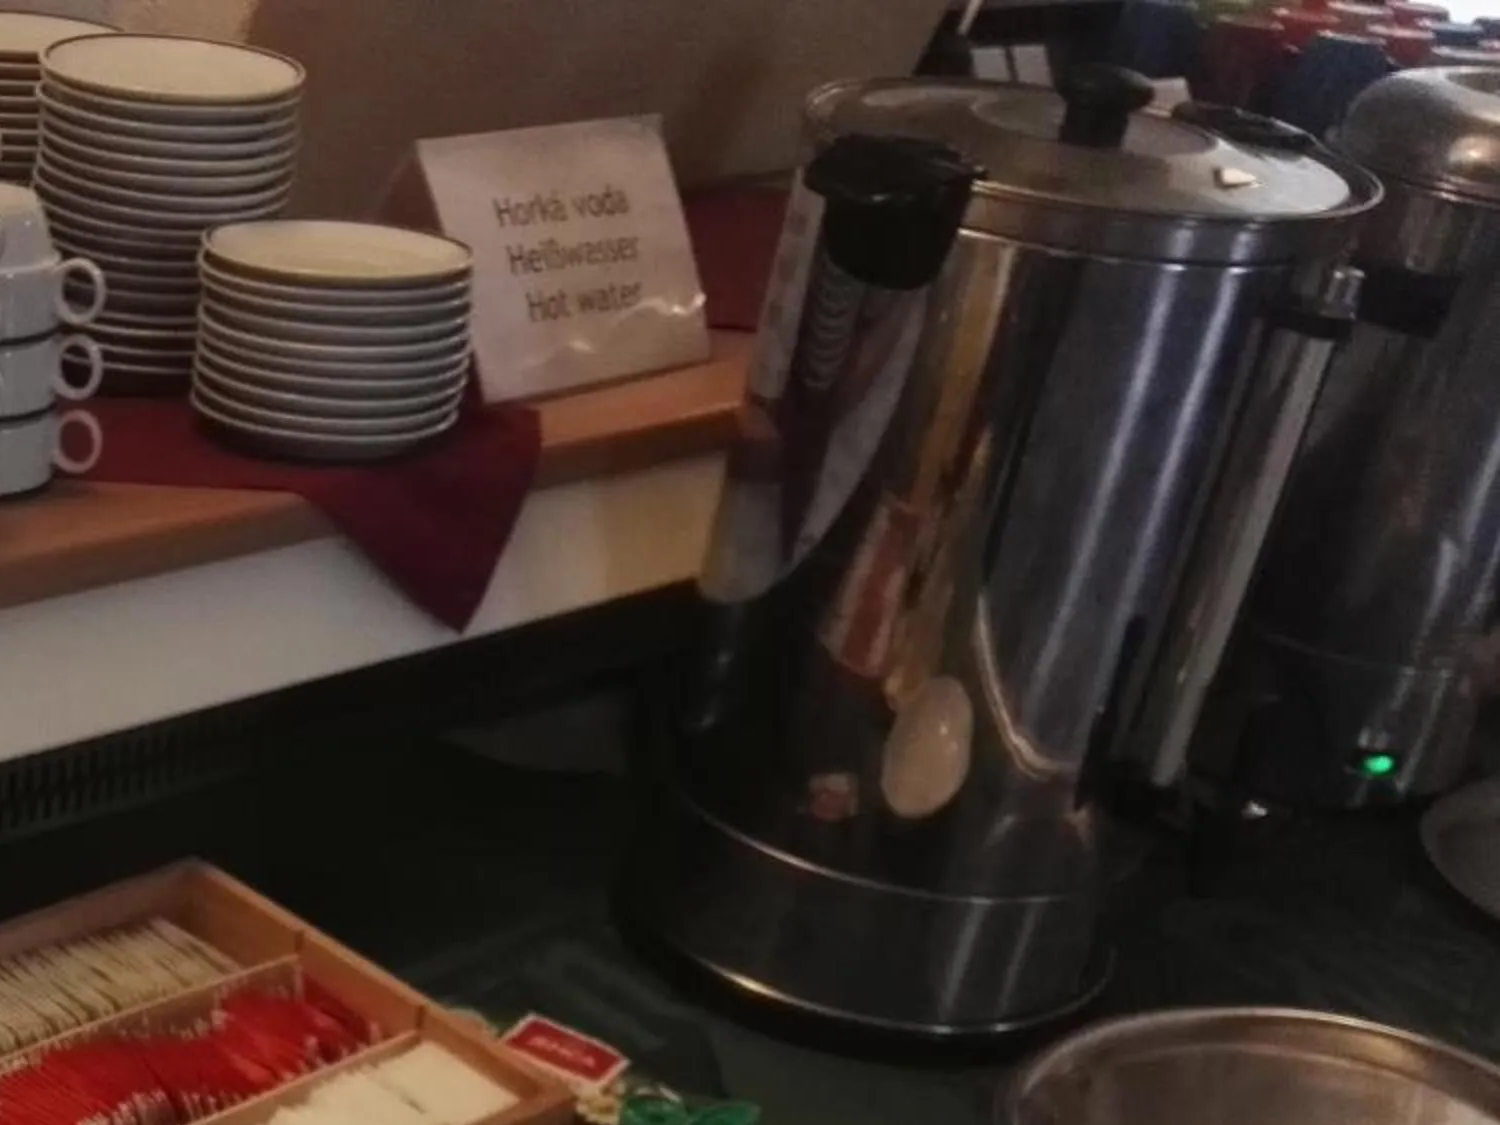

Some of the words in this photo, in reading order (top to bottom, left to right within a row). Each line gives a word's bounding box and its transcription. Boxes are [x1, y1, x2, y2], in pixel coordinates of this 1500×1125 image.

[571, 184, 631, 217] voda
[525, 289, 571, 323] Hot
[576, 281, 642, 313] water
